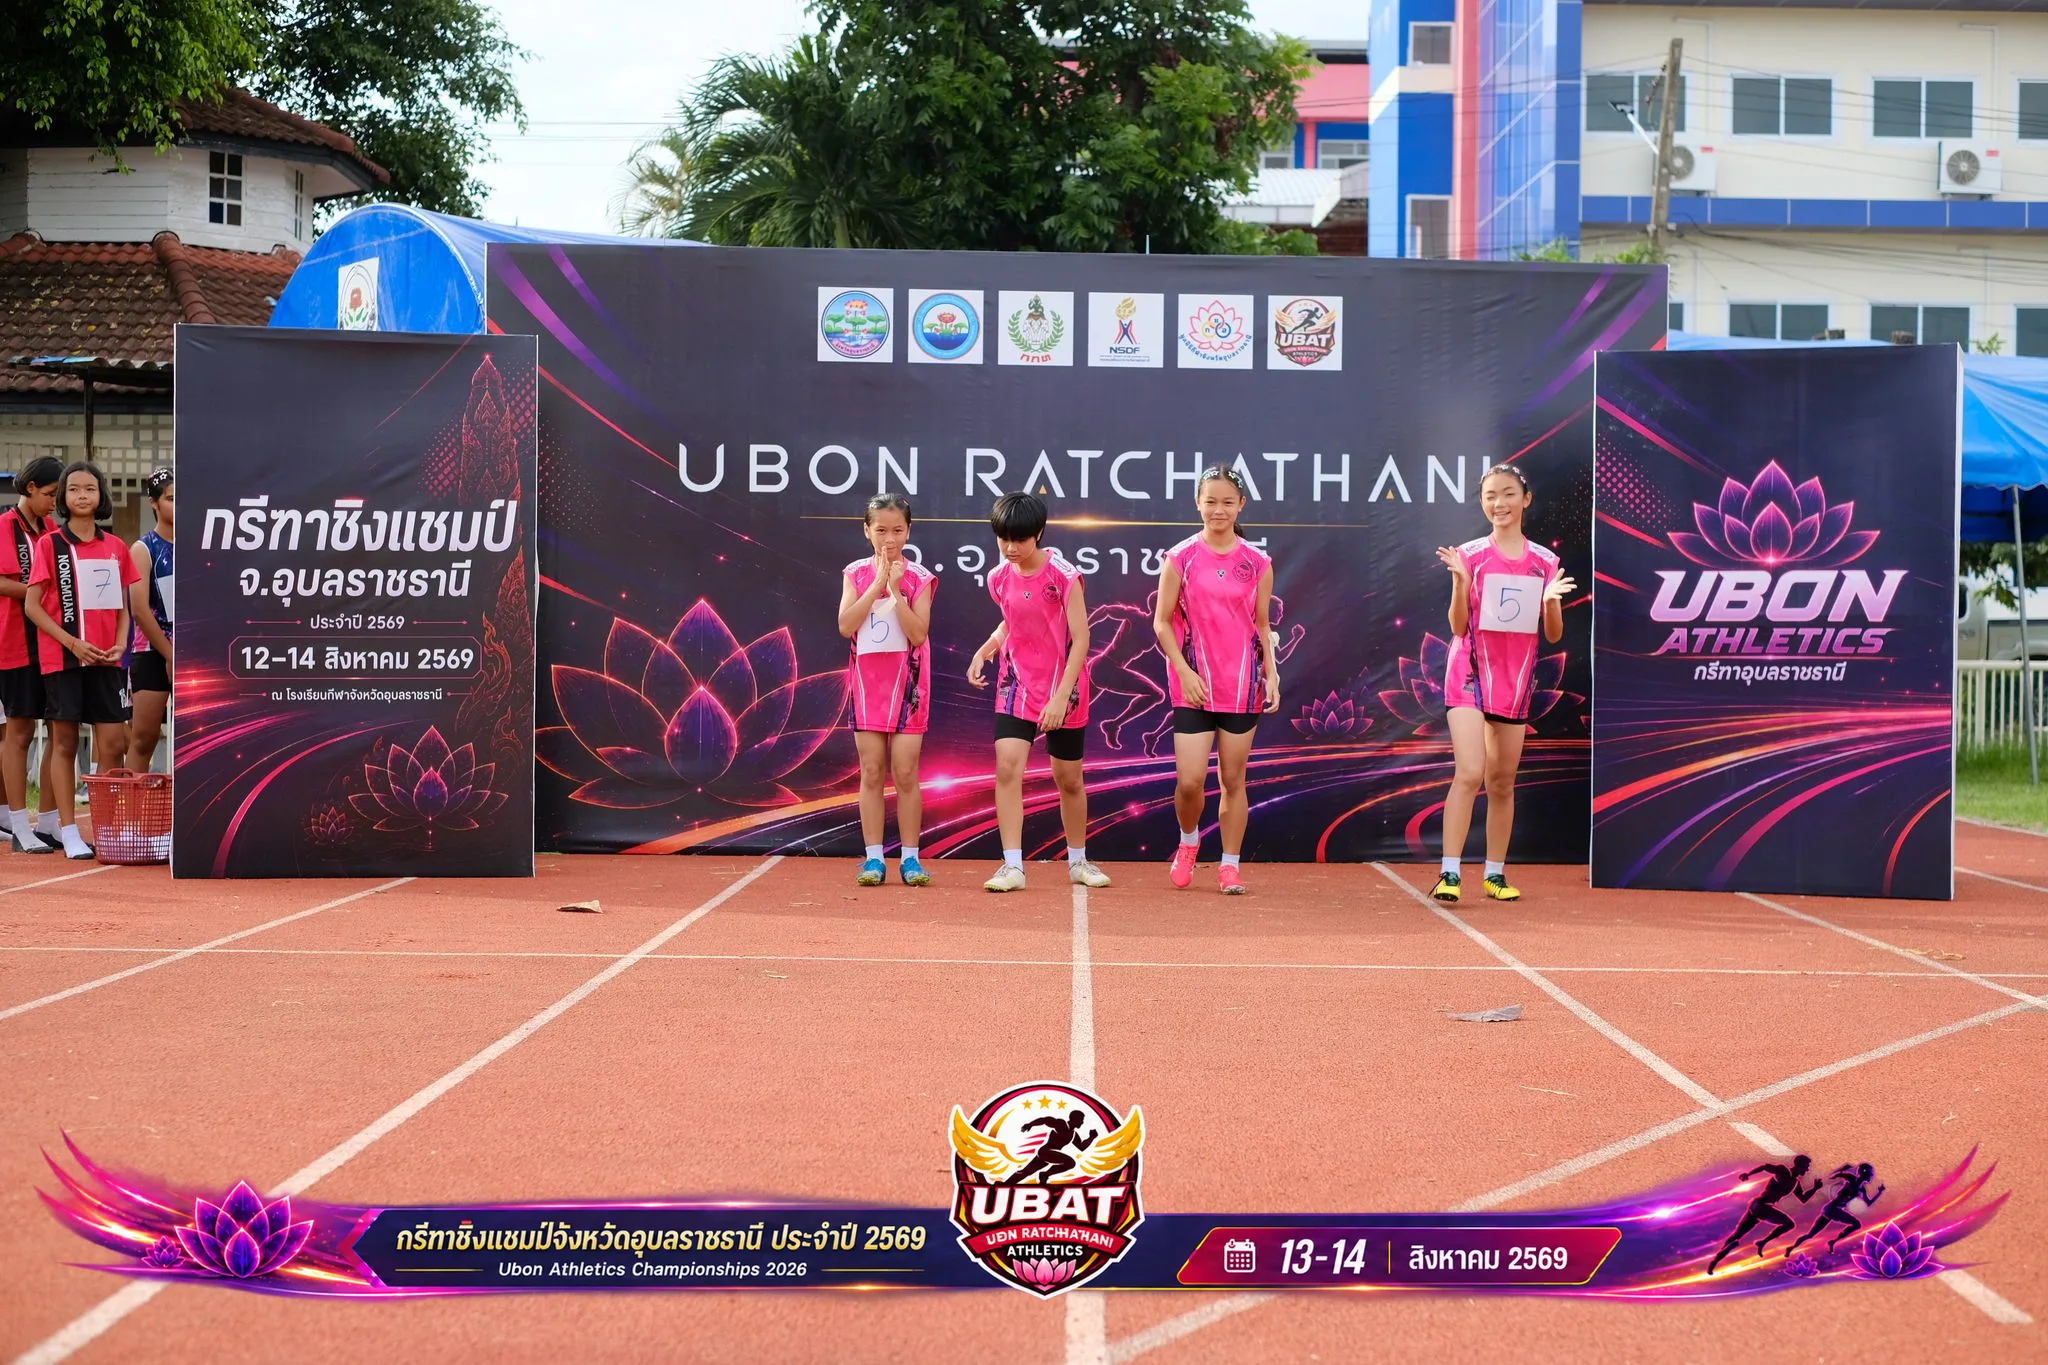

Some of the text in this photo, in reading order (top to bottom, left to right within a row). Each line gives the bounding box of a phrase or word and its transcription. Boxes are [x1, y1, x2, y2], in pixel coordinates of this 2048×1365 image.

[1109, 346, 1141, 355] NSDF
[1279, 333, 1331, 347] UBAT
[678, 442, 918, 496] UBON
[200, 494, 518, 552] กรีฑาชิงแชมป์
[18, 544, 30, 584] NONGM
[57, 554, 75, 623] NONGMUANG
[93, 569, 111, 599] 7
[239, 559, 472, 608] จ.อุบลราชธานี
[1649, 569, 1909, 623] UBON
[1497, 587, 1522, 623] 5
[310, 613, 405, 630] ประจำปี 2569
[870, 612, 890, 643] 5
[1662, 627, 1892, 654] ATHLETICS
[324, 646, 409, 670] สิงหาคม
[417, 648, 474, 670] 2569
[1693, 660, 1847, 686] กรีฑาอุบลราชธานี
[271, 687, 443, 704] ณ โรงเรียนกีฬาจังหวัดอุบลราชธานี
